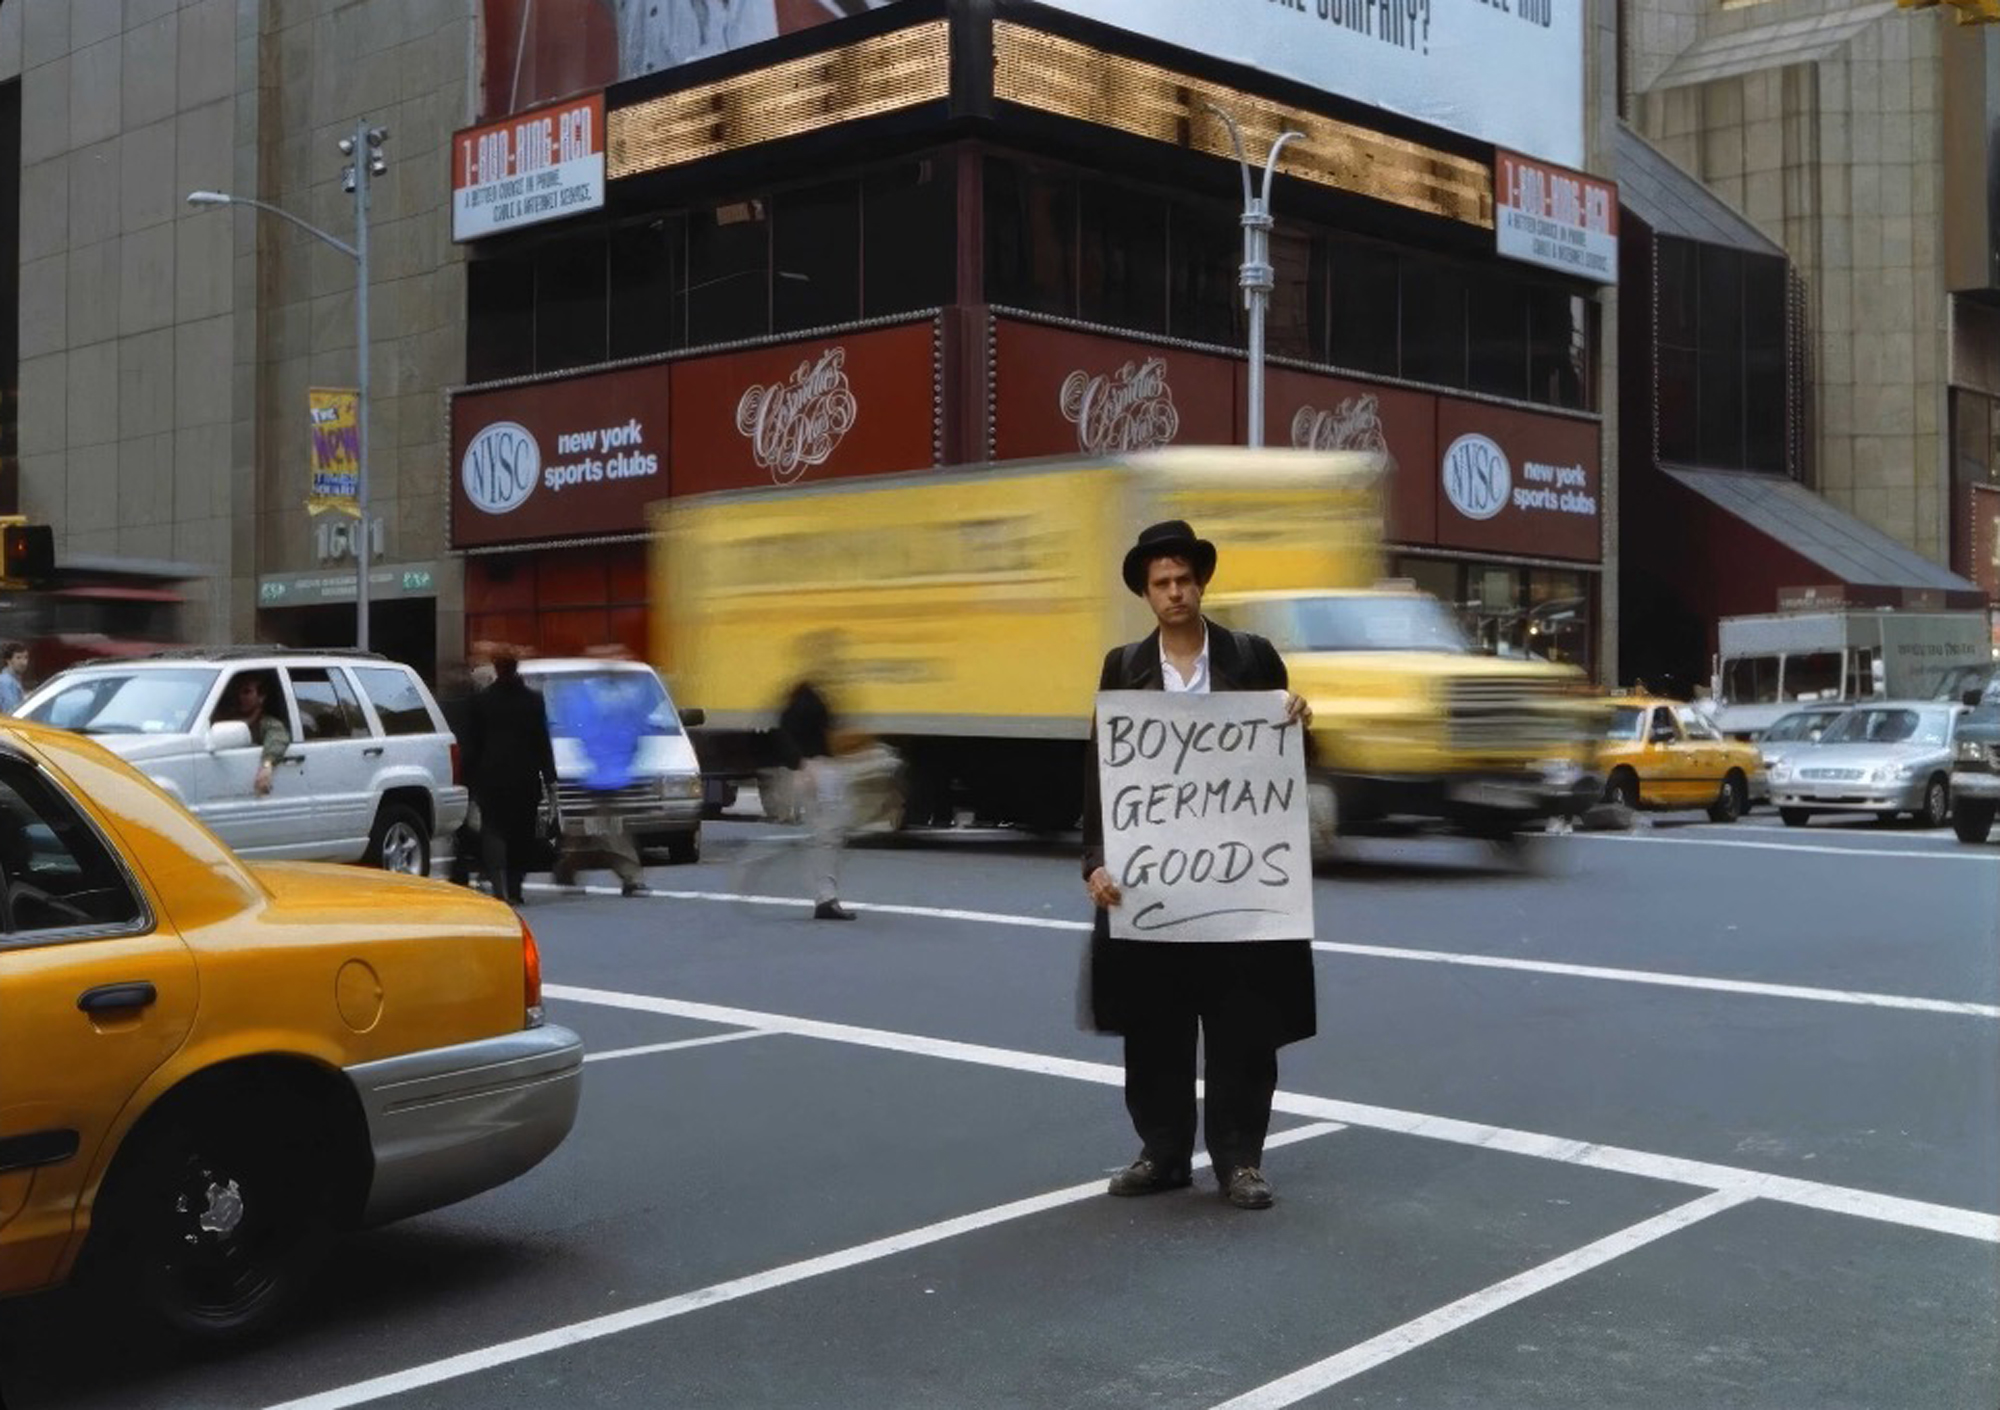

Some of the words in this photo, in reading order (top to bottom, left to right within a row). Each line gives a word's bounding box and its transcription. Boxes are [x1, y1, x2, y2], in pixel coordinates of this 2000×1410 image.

[558, 429, 597, 455] new
[600, 418, 643, 454] york
[471, 431, 530, 504] NYSC
[544, 457, 604, 492] sports
[606, 450, 658, 479] clubs
[1451, 442, 1503, 510] NYSC
[1523, 461, 1554, 482] new
[1555, 464, 1586, 488] york
[1513, 487, 1558, 511] sports
[1560, 489, 1597, 515] clubs
[1103, 715, 1298, 775] BOYCOTT
[1111, 778, 1295, 832] GERMAN
[1122, 841, 1291, 888] GOODS
